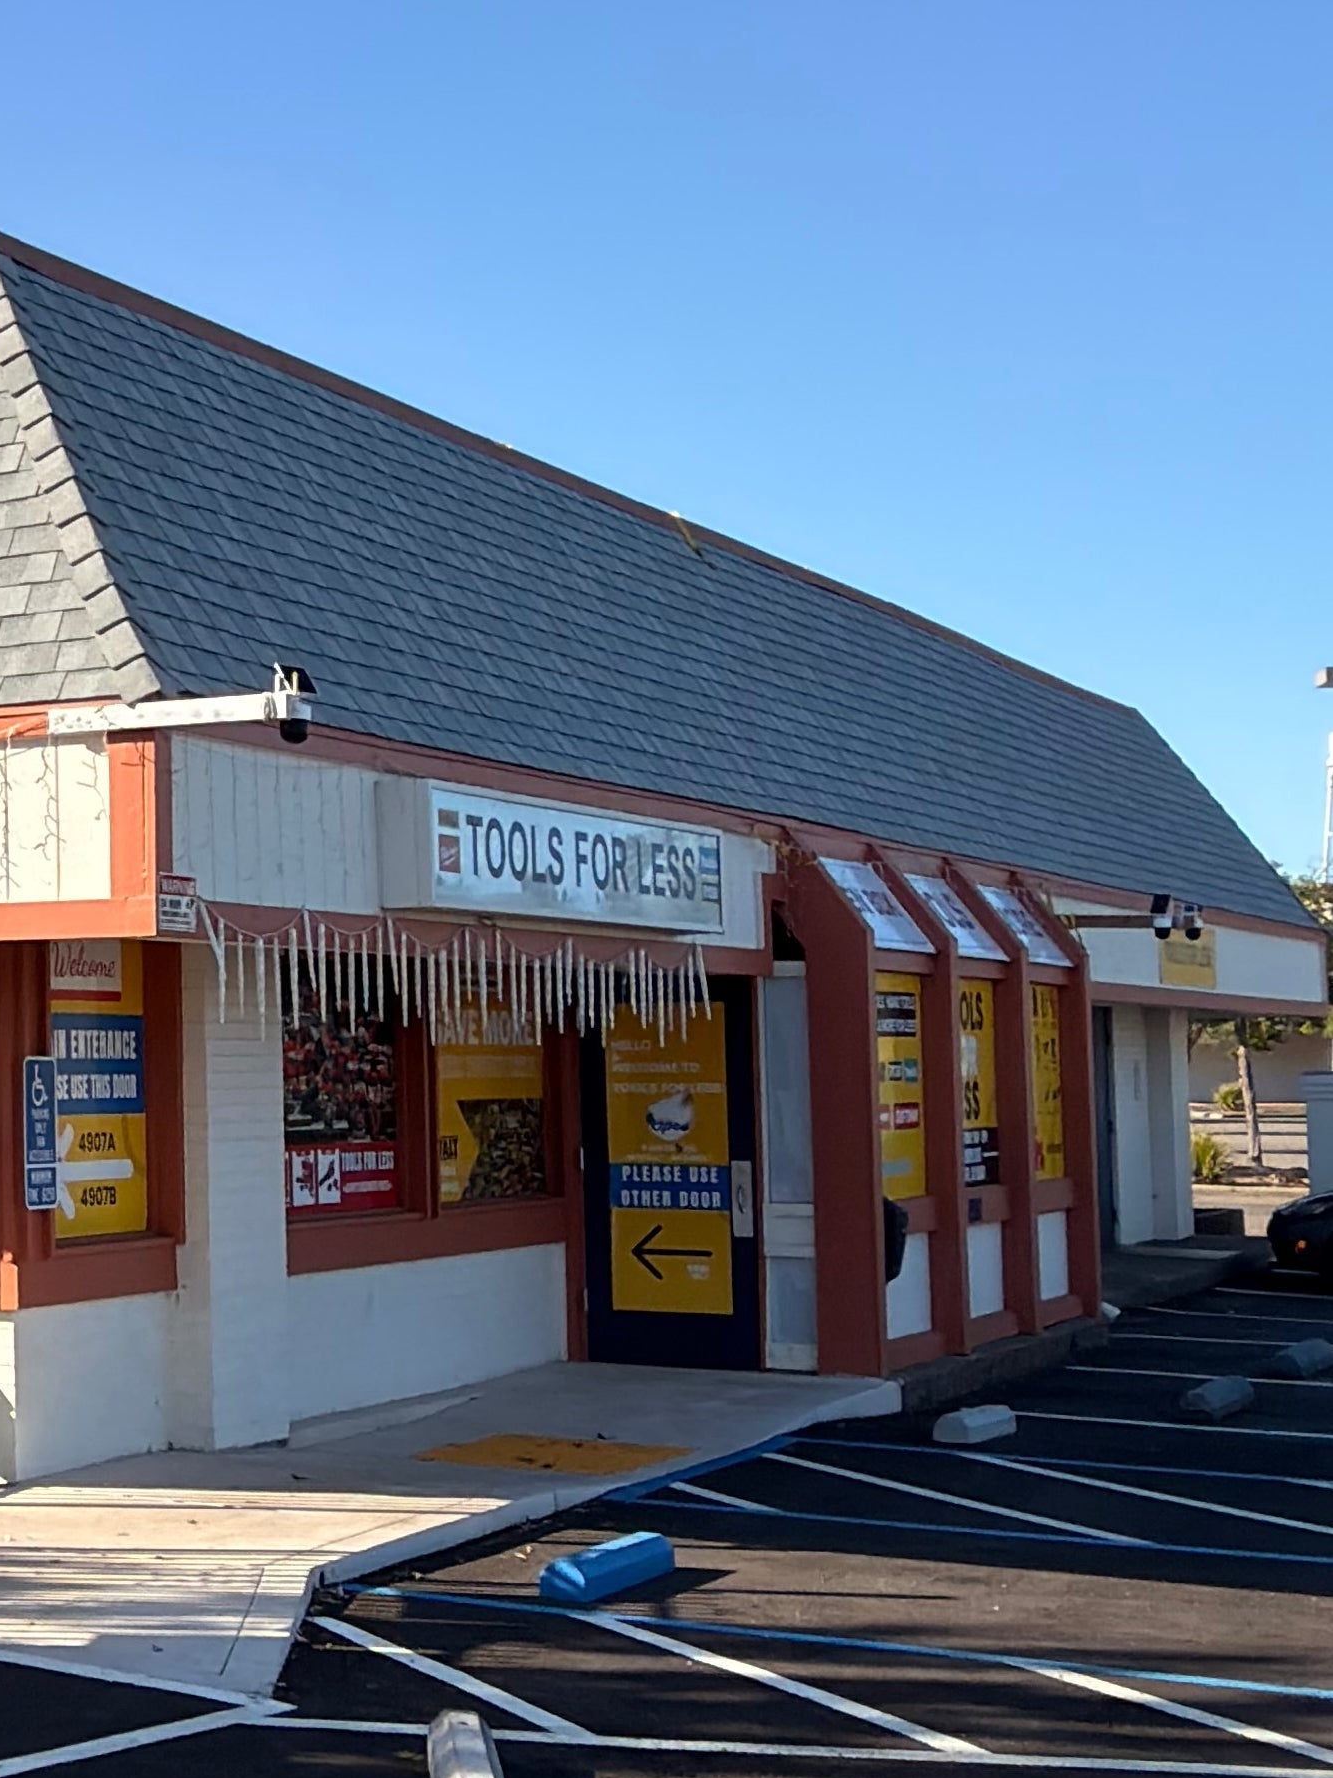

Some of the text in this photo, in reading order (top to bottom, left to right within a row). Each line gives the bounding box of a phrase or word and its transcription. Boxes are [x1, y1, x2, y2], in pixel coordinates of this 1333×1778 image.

[466, 814, 565, 886] TOOLS
[574, 831, 629, 893] FOR
[637, 840, 697, 901] LESS
[51, 941, 116, 978] Welcome
[70, 1074, 89, 1100] USE
[90, 1074, 111, 1099] THIS
[112, 1074, 137, 1099] DOOR
[78, 1131, 116, 1153] 4907A
[621, 1165, 719, 1184] PLEASE USE
[80, 1186, 117, 1207] 4907B
[620, 1189, 722, 1209] OTHER DOOR
